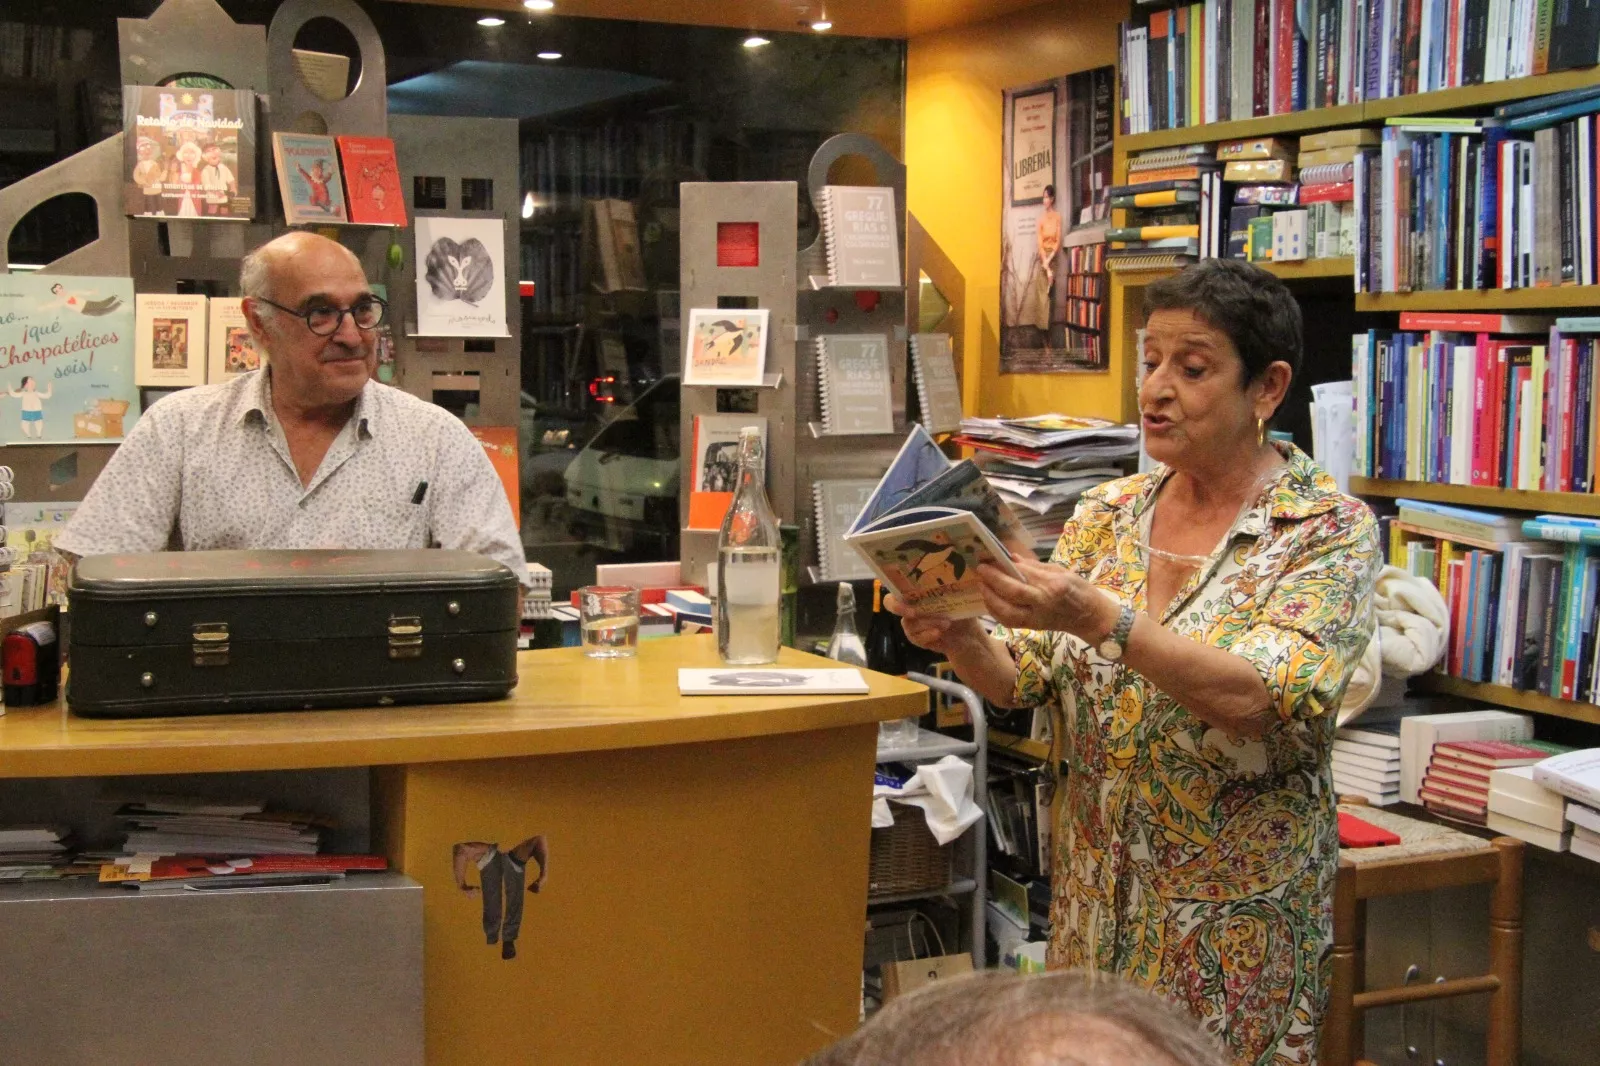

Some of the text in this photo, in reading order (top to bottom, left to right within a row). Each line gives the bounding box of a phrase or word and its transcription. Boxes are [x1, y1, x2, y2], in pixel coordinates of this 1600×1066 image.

[1368, 26, 1380, 90] HISTORIA
[137, 115, 243, 129] Retablo de Navidad
[867, 196, 883, 209] 77
[23, 317, 61, 345] ¡qué
[861, 344, 878, 358] 77
[54, 351, 94, 379] sois!
